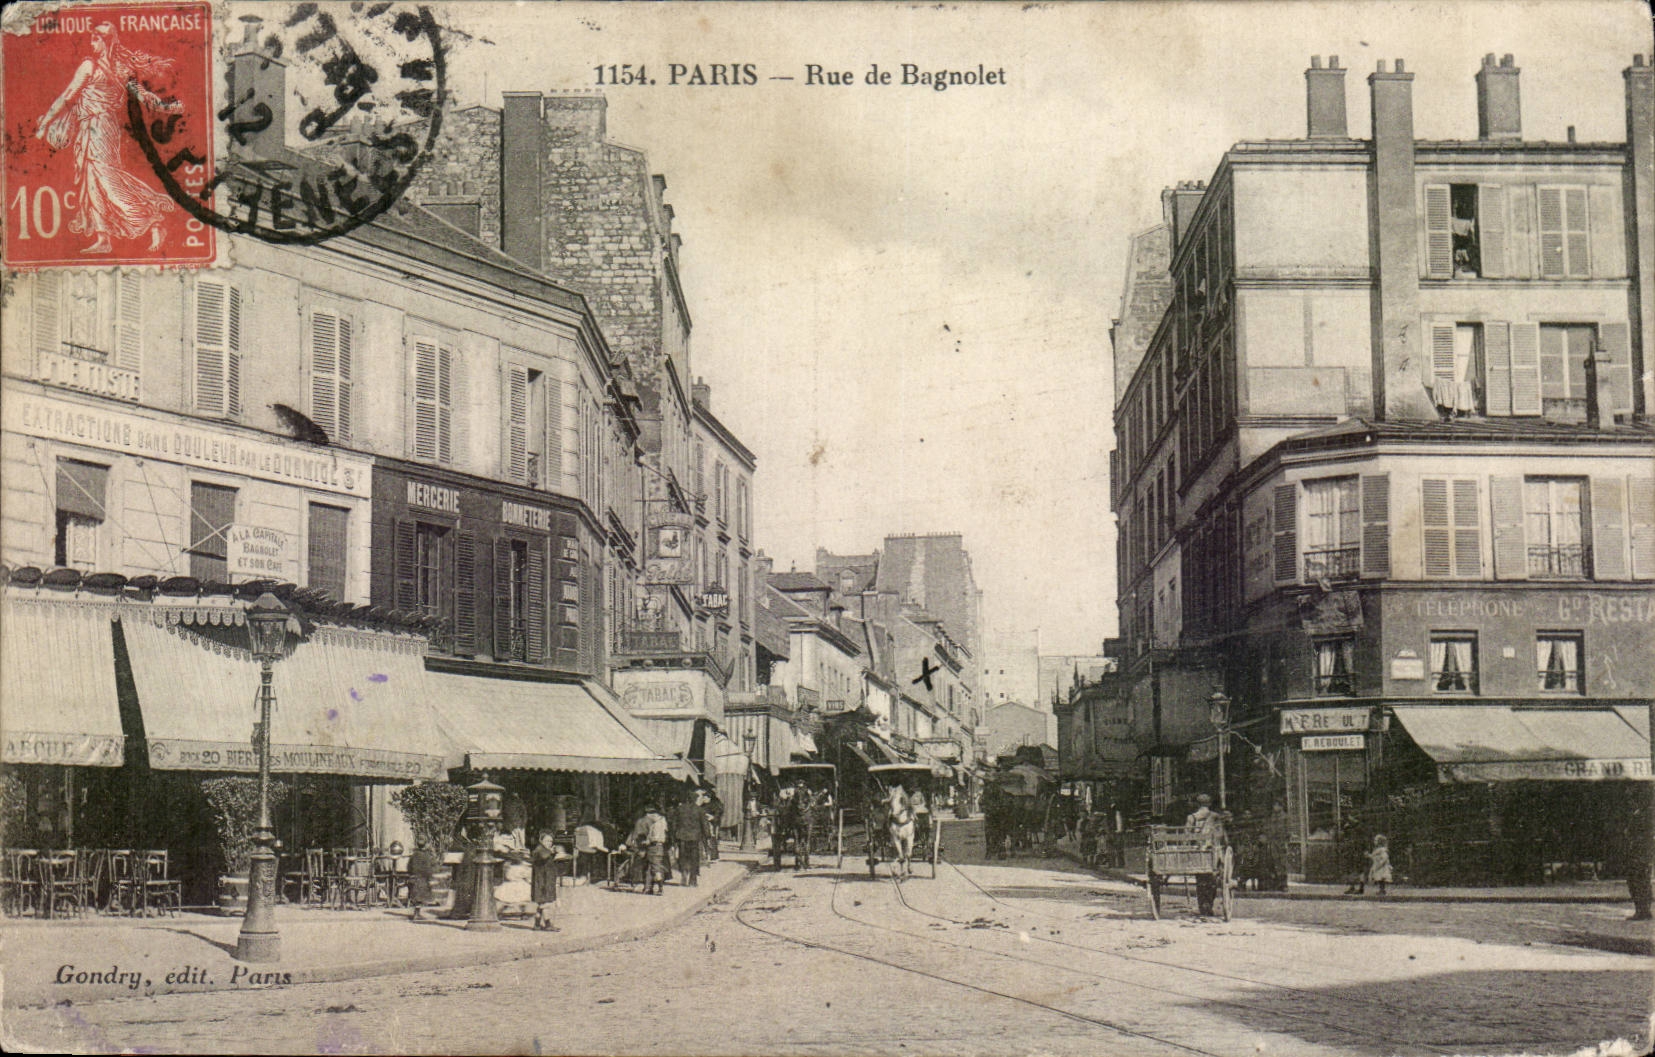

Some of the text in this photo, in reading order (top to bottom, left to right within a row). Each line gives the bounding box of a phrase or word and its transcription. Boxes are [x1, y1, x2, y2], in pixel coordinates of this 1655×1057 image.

[119, 13, 201, 33] FRANÇAISE
[23, 402, 131, 447] EXTRACTIONS
[174, 432, 238, 466] DOULEUR
[407, 480, 460, 514] MERCERIE
[502, 501, 551, 531] BONNETERIE
[239, 529, 251, 541] LA
[250, 558, 265, 569] SON
[201, 750, 221, 765] 20
[283, 751, 356, 770] MOULINEAUX
[1564, 760, 1623, 777] GRAND
